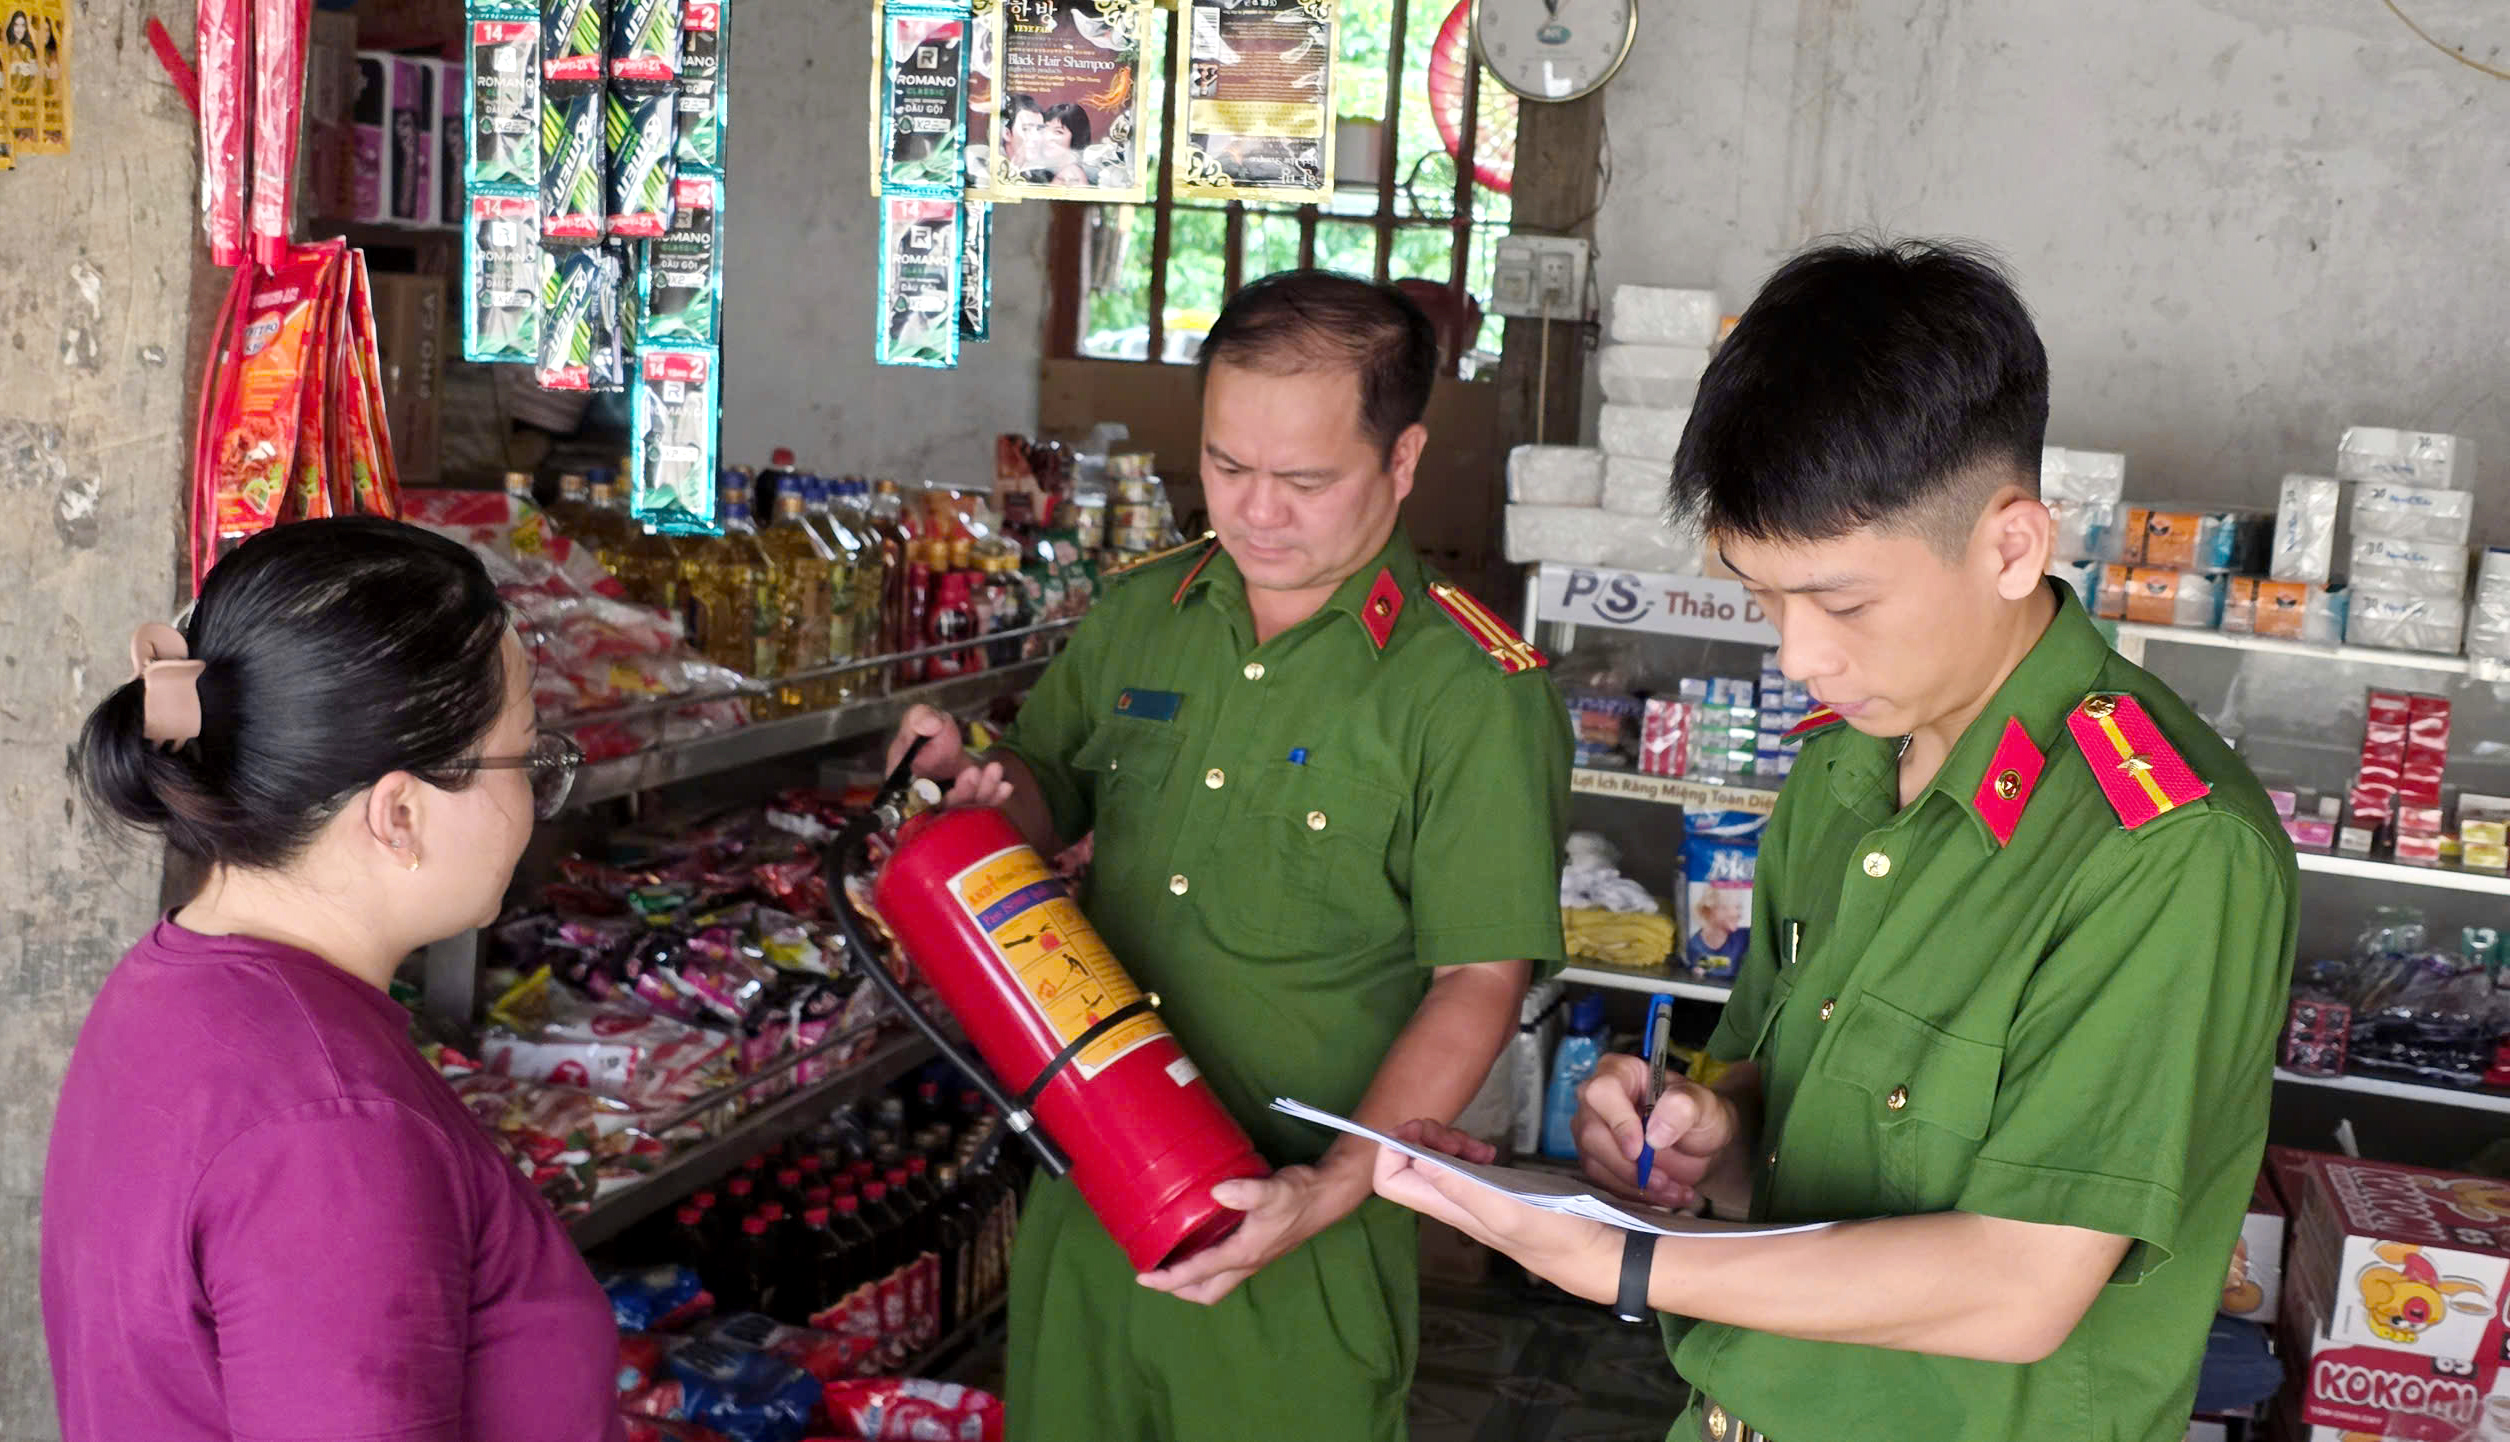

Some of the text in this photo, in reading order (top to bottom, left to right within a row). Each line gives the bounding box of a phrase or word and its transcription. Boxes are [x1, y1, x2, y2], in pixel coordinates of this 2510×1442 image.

[701, 6, 715, 29] 2
[1611, 10, 1622, 25] 3
[483, 24, 503, 41] 14
[921, 50, 934, 65] R
[1008, 53, 1115, 73] Black Hair Shampoo
[478, 76, 535, 88] ROMANO
[896, 74, 957, 88] ROMANO
[698, 184, 711, 205] 2
[892, 254, 949, 265] ROMANO
[689, 359, 705, 380] 2
[1664, 589, 1735, 621] Thảo
[1748, 793, 1774, 810] Diệ
[2314, 1360, 2478, 1424] KOKOMI
